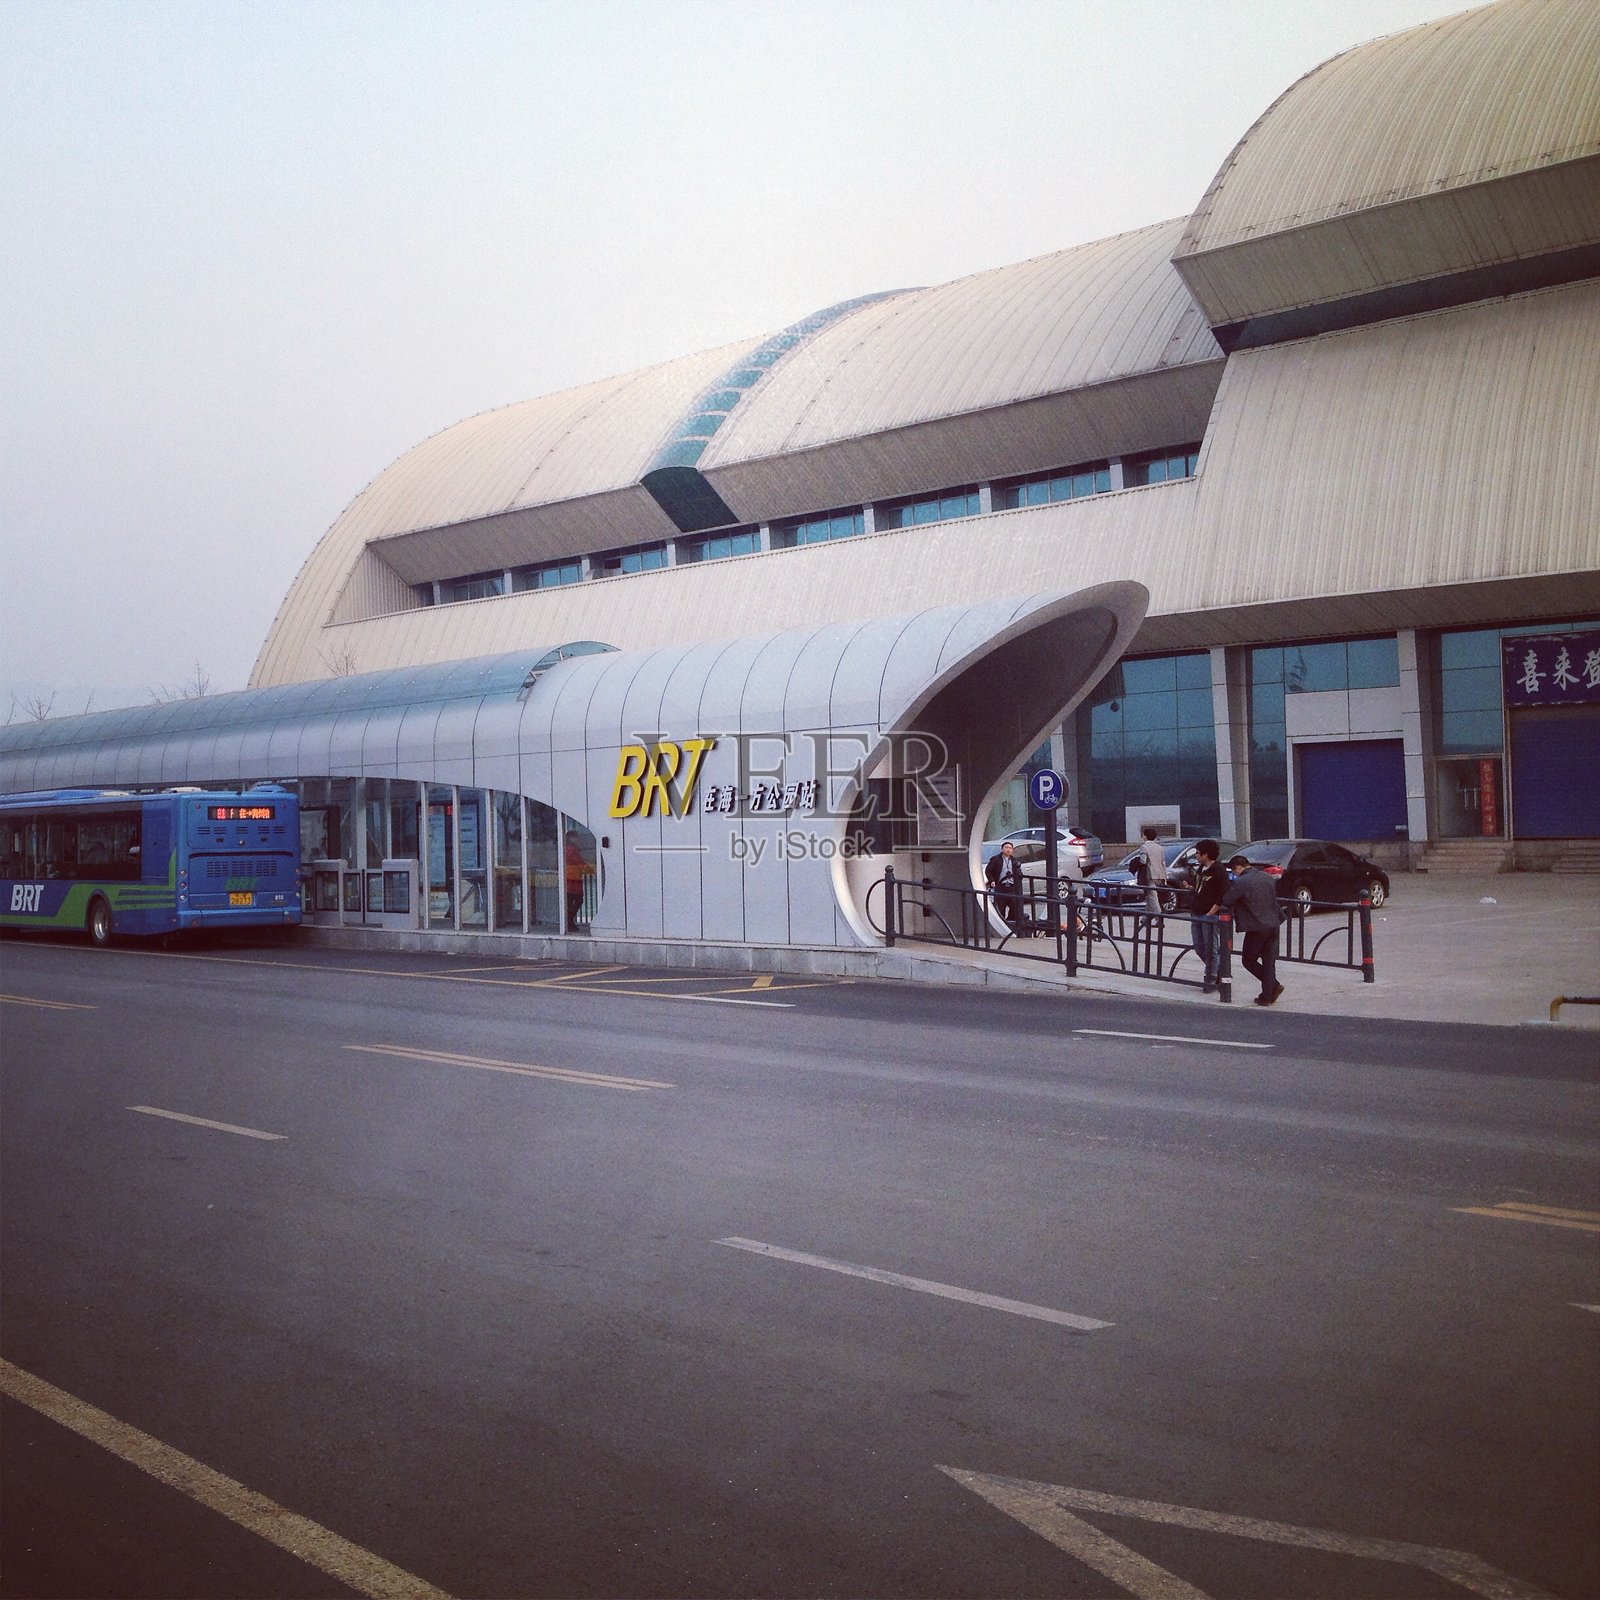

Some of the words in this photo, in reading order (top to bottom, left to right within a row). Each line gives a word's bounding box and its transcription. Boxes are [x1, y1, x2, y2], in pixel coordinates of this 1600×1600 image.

[609, 739, 717, 818] BRT
[1039, 775, 1054, 801] P
[225, 877, 258, 891] BRT
[10, 885, 45, 912] BRT
